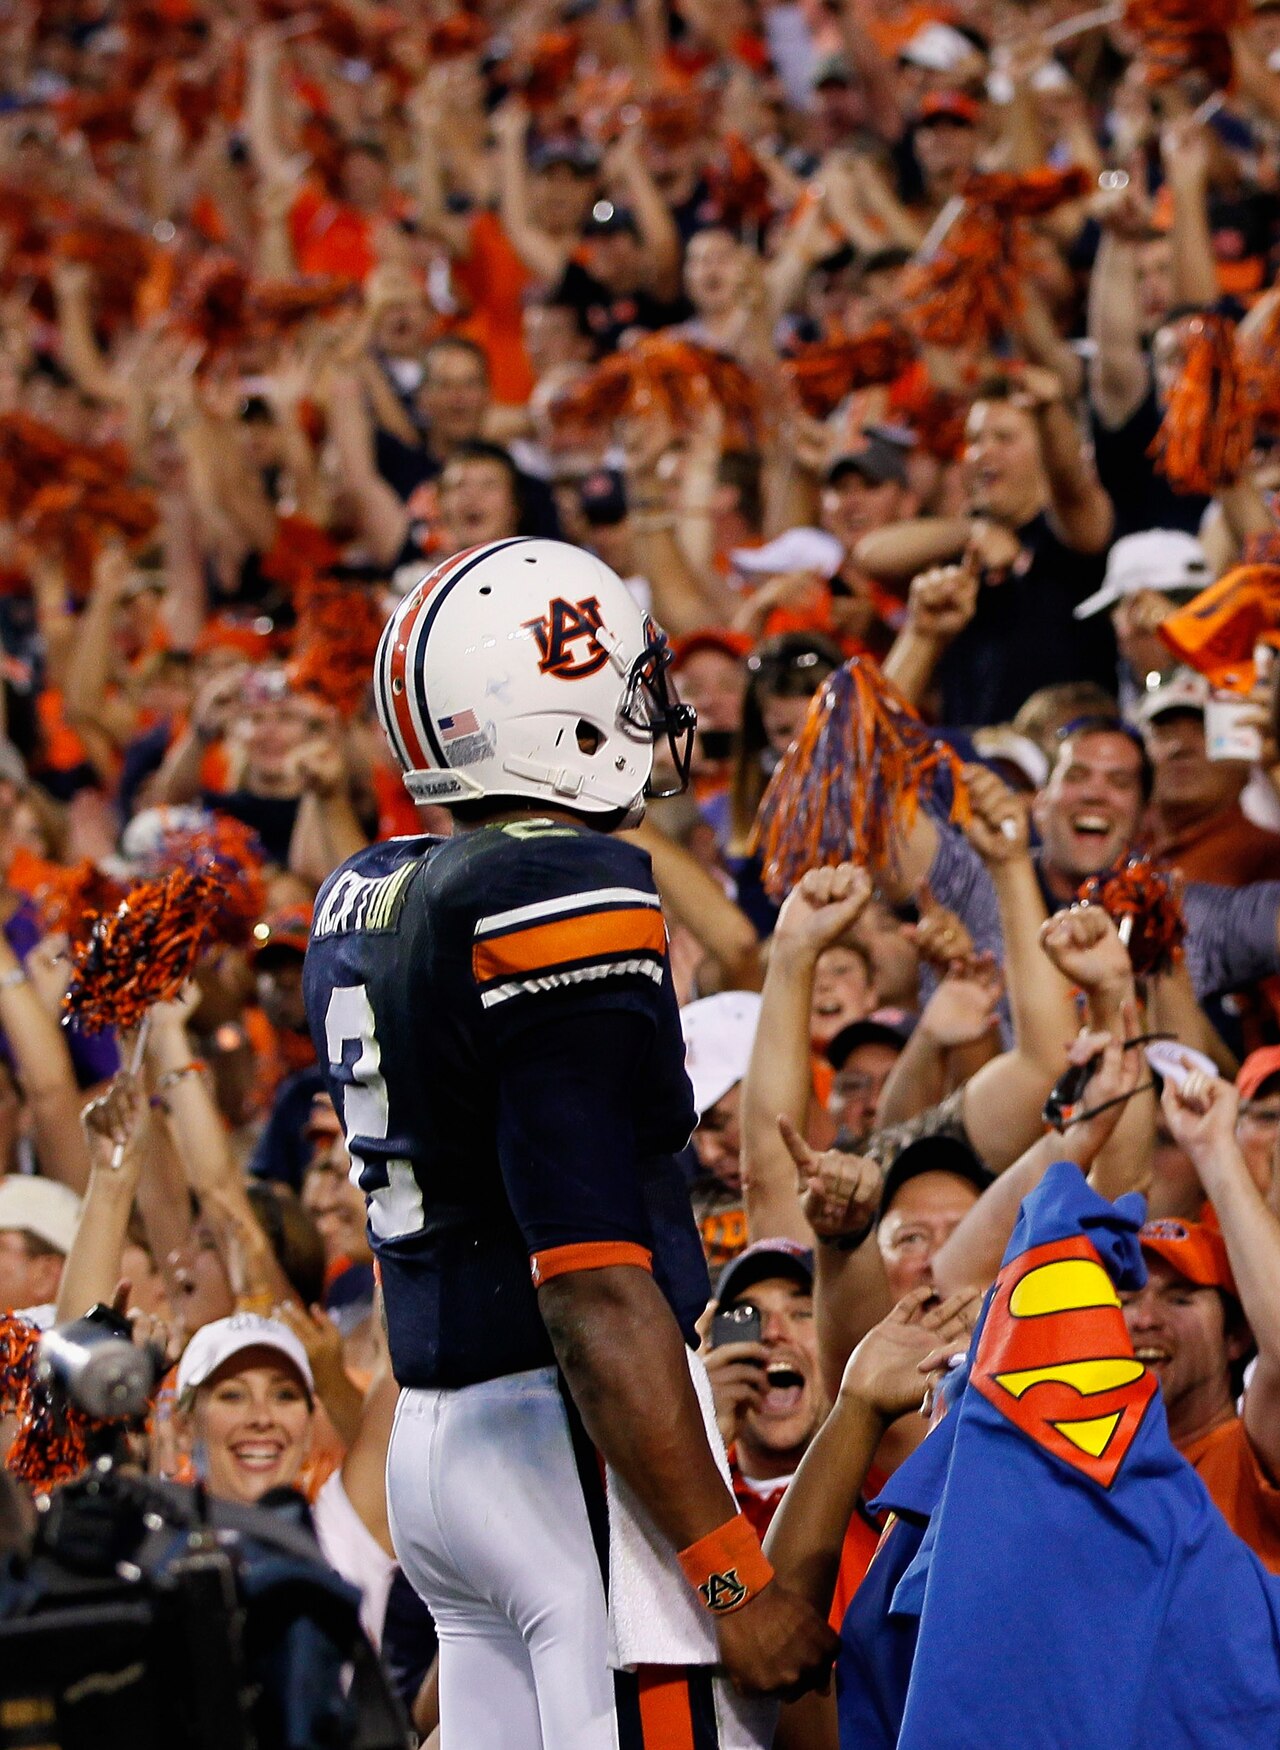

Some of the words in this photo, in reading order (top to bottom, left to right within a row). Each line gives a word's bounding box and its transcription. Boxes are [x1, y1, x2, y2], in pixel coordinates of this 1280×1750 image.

[520, 595, 610, 682] AU
[325, 983, 425, 1239] 2
[697, 1567, 748, 1611] AU
